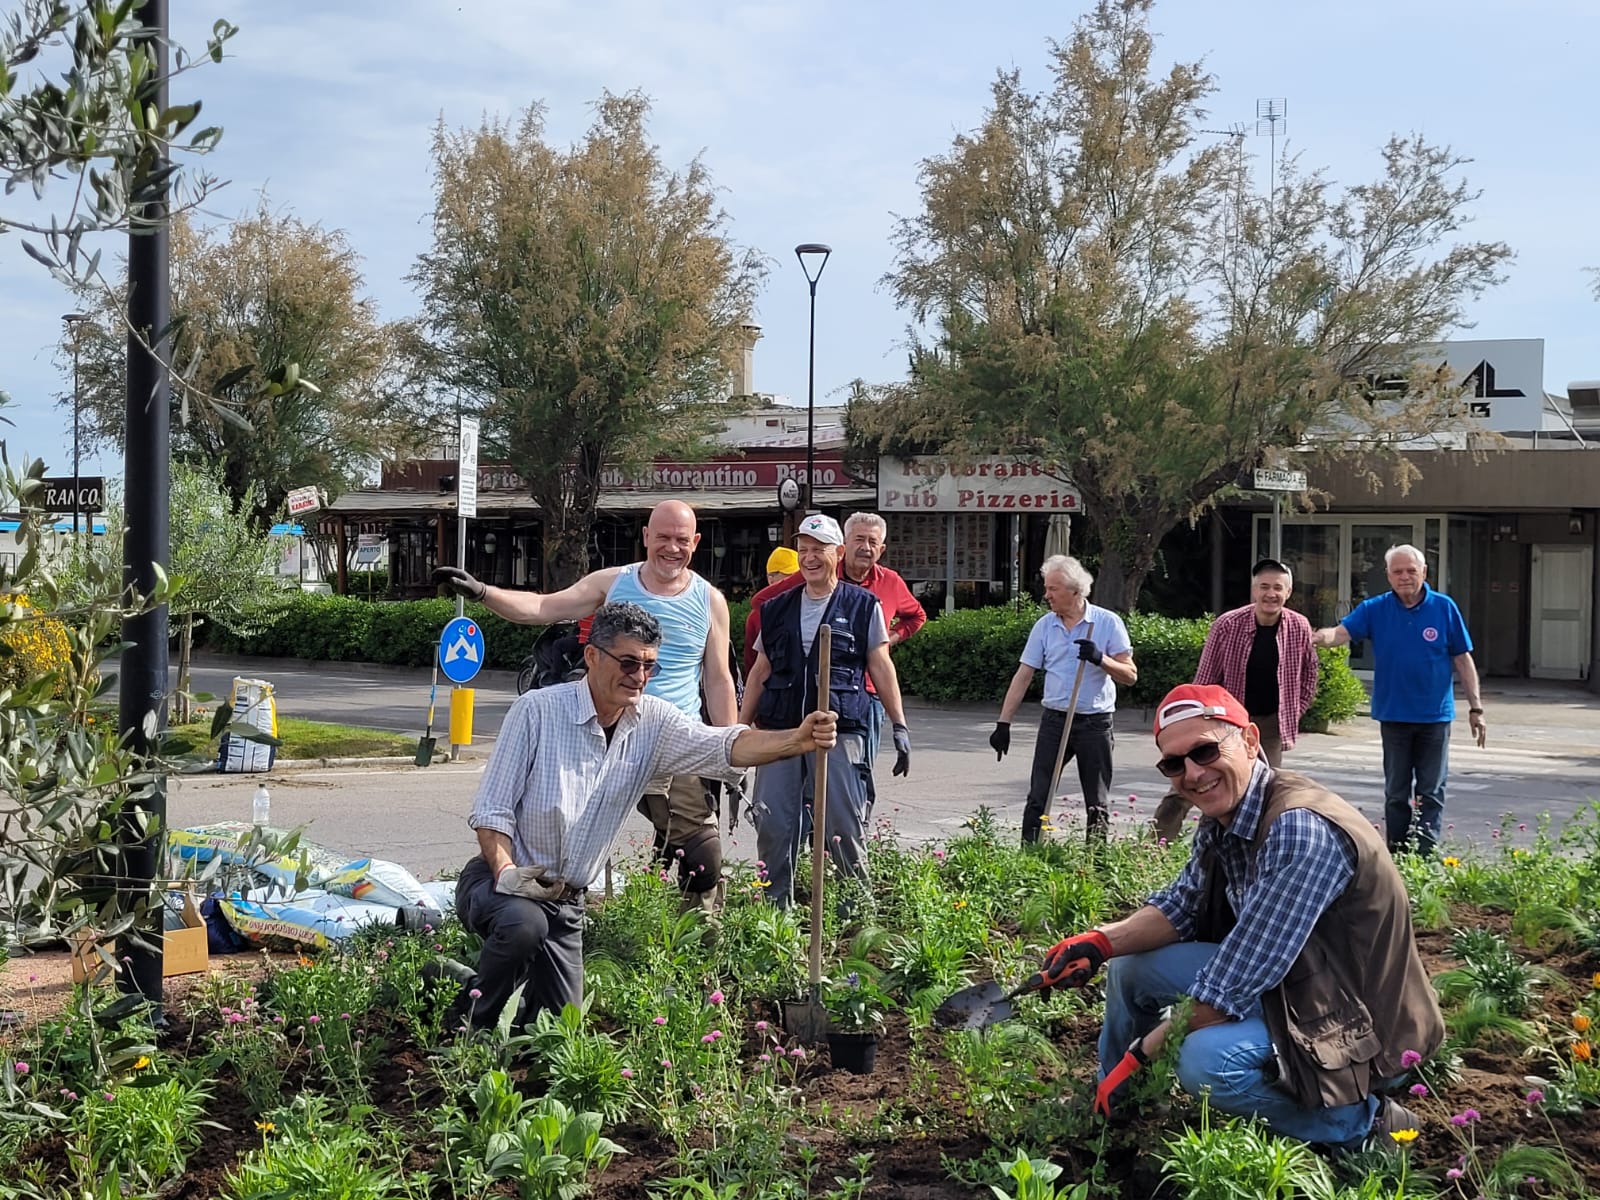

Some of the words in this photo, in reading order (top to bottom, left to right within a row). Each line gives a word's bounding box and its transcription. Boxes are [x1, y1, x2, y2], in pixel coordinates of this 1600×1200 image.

[776, 464, 836, 485] Piano
[44, 488, 99, 506] RANCO
[885, 490, 938, 507] Pub
[957, 490, 1076, 508] Pizzeria
